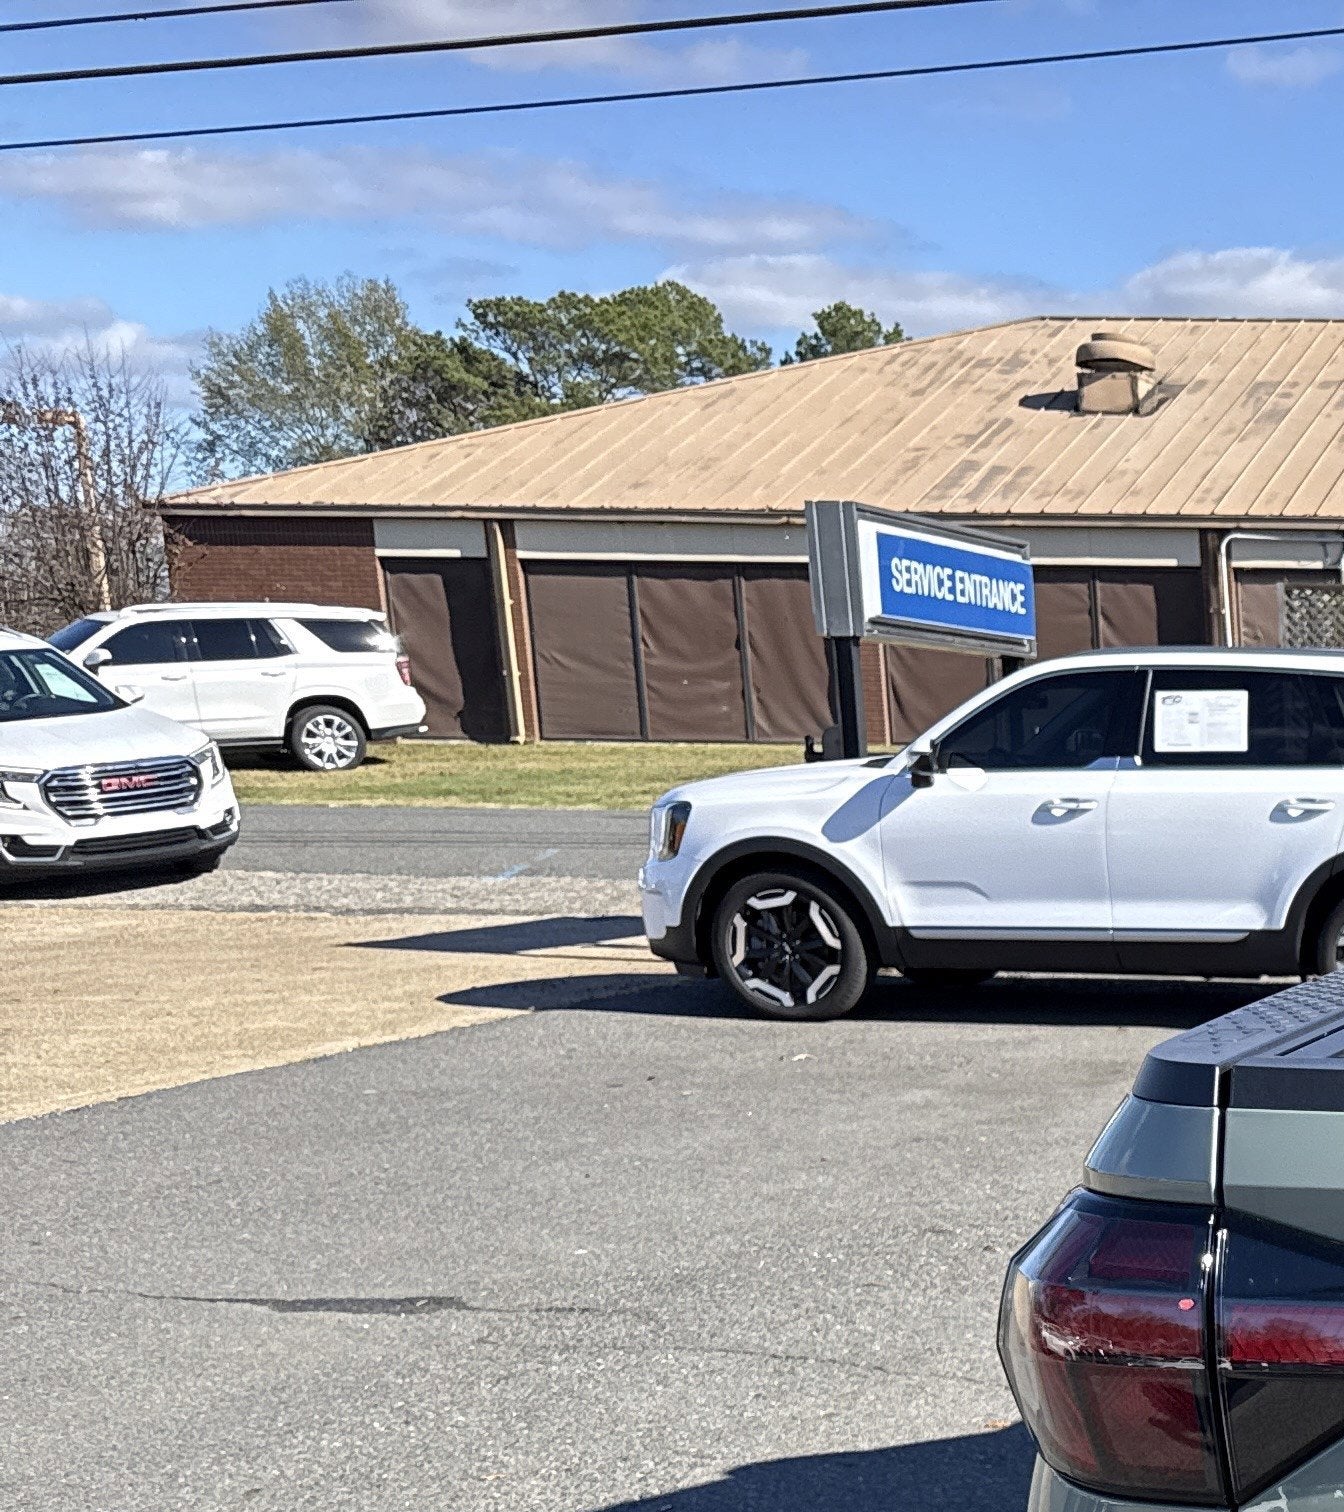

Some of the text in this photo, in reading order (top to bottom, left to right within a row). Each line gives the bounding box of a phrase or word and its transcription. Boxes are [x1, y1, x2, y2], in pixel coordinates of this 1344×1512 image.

[890, 557, 1027, 615] SERVICE ENTRANCE
[101, 774, 156, 792] GMC
